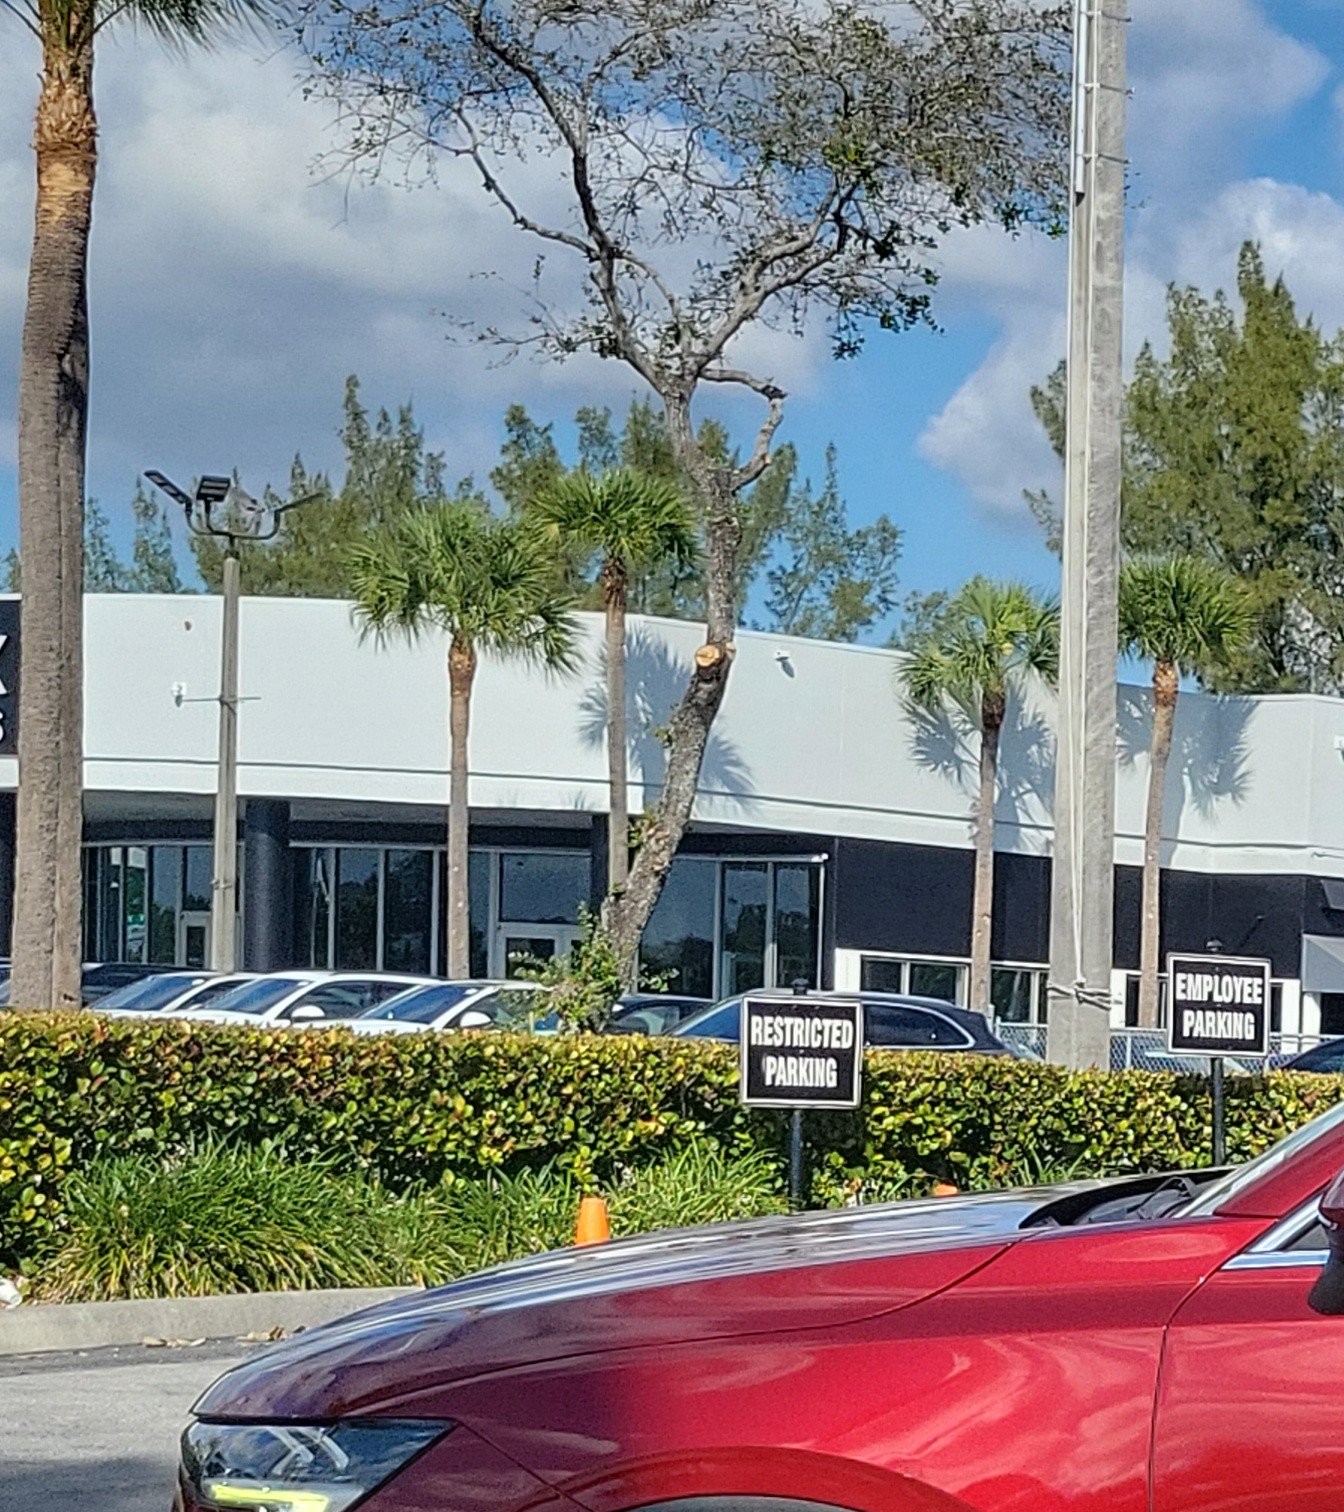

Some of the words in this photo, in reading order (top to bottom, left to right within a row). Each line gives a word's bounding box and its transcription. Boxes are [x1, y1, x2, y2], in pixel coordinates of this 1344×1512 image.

[1175, 972, 1263, 1004] EMPLOYEE
[750, 1015, 854, 1049] RESTRICTED
[1182, 1009, 1255, 1040] PARKING
[763, 1055, 838, 1088] PARKING
